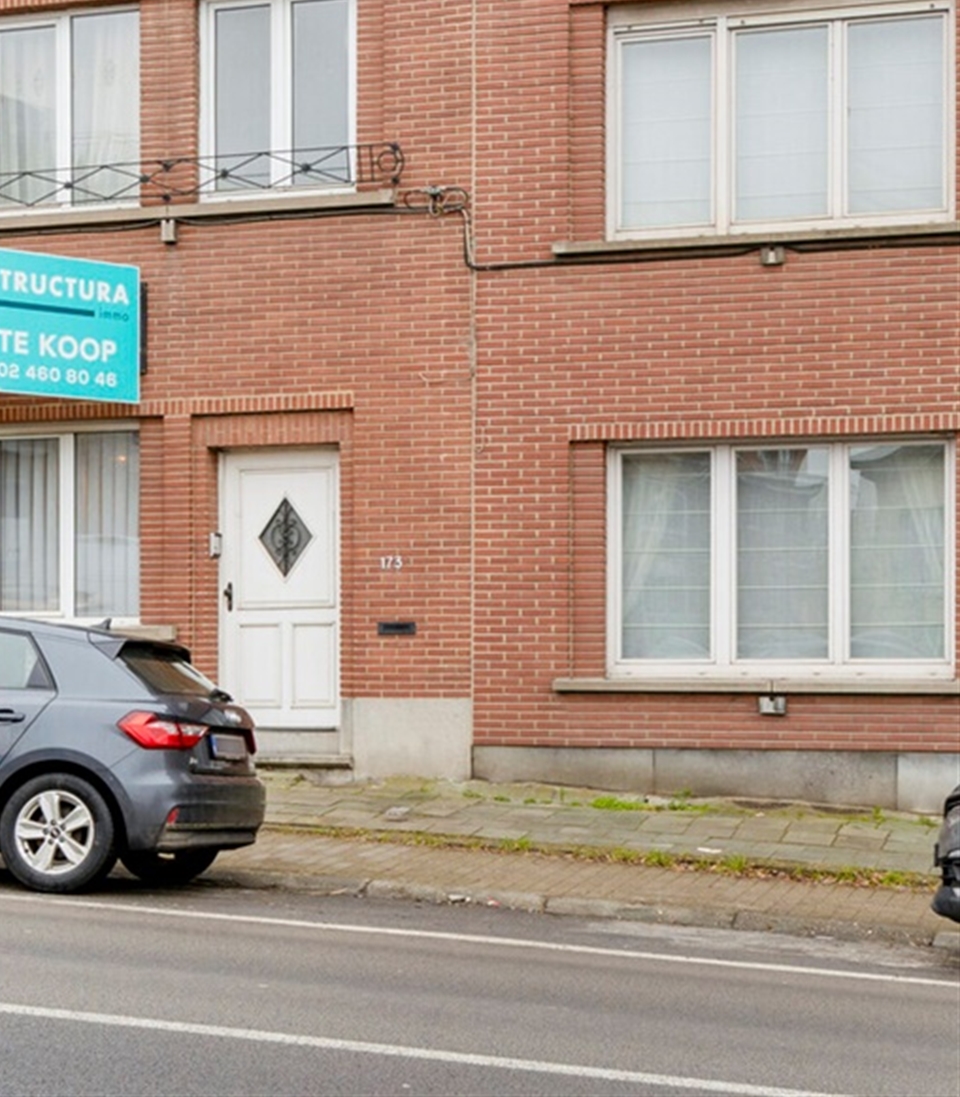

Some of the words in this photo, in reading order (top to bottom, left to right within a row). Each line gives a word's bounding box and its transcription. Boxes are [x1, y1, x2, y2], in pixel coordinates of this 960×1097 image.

[98, 307, 130, 322] immo
[39, 333, 117, 363] KOOP
[65, 368, 90, 385] 80
